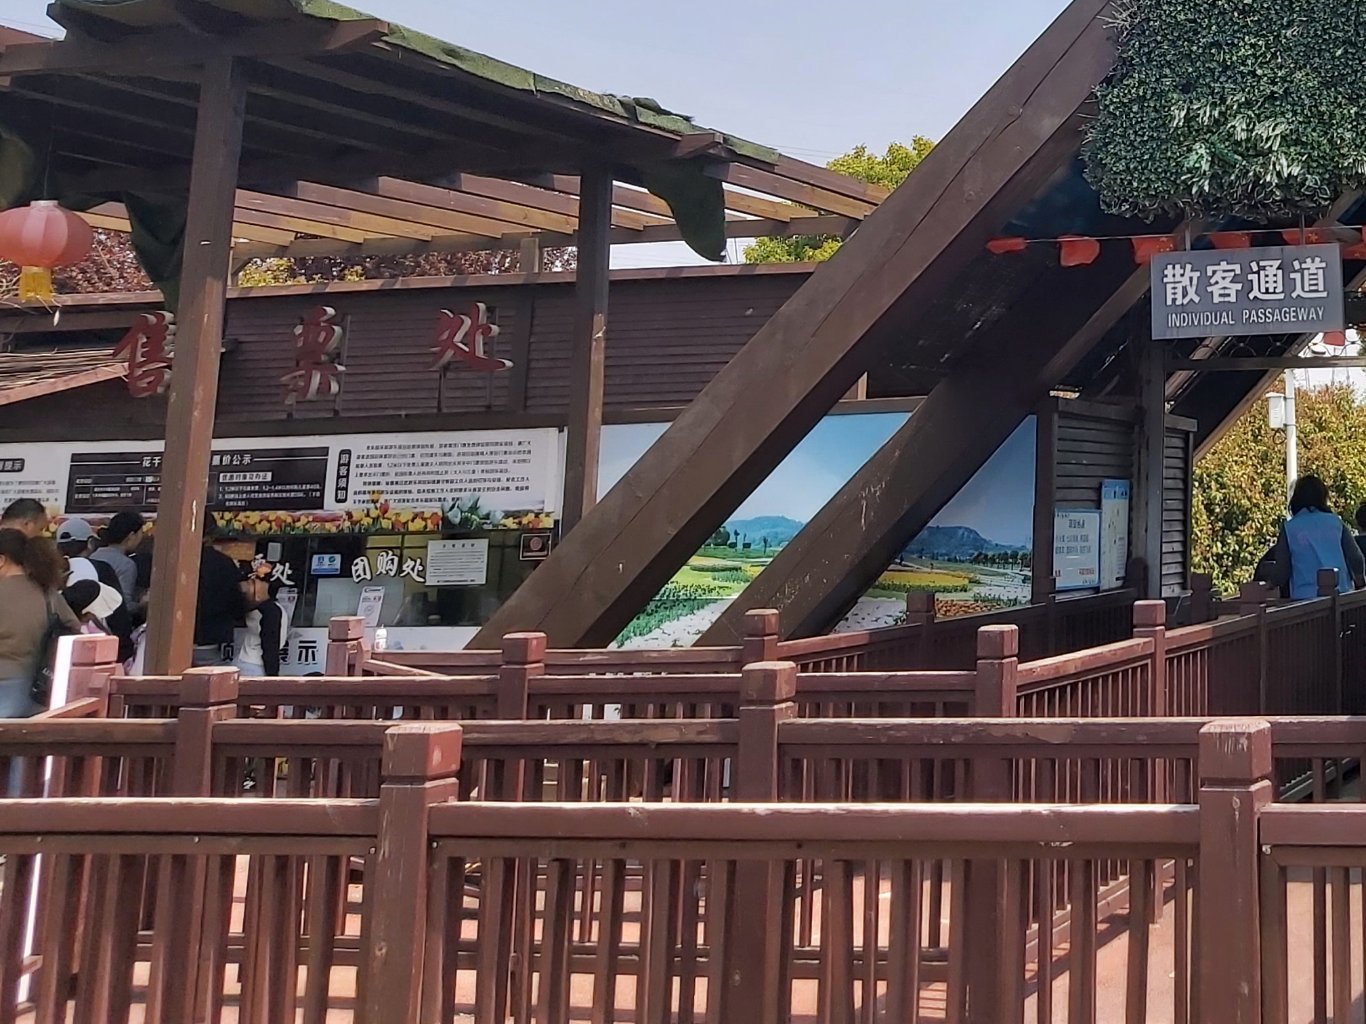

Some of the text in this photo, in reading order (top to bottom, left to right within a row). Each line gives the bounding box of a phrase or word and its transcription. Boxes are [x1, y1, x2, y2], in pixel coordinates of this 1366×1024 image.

[1163, 257, 1328, 306] 散客通道
[1167, 306, 1325, 328] INDIVIDUAL PASSAGEWAY
[112, 301, 514, 406] 售票处
[350, 550, 426, 583] 团购处
